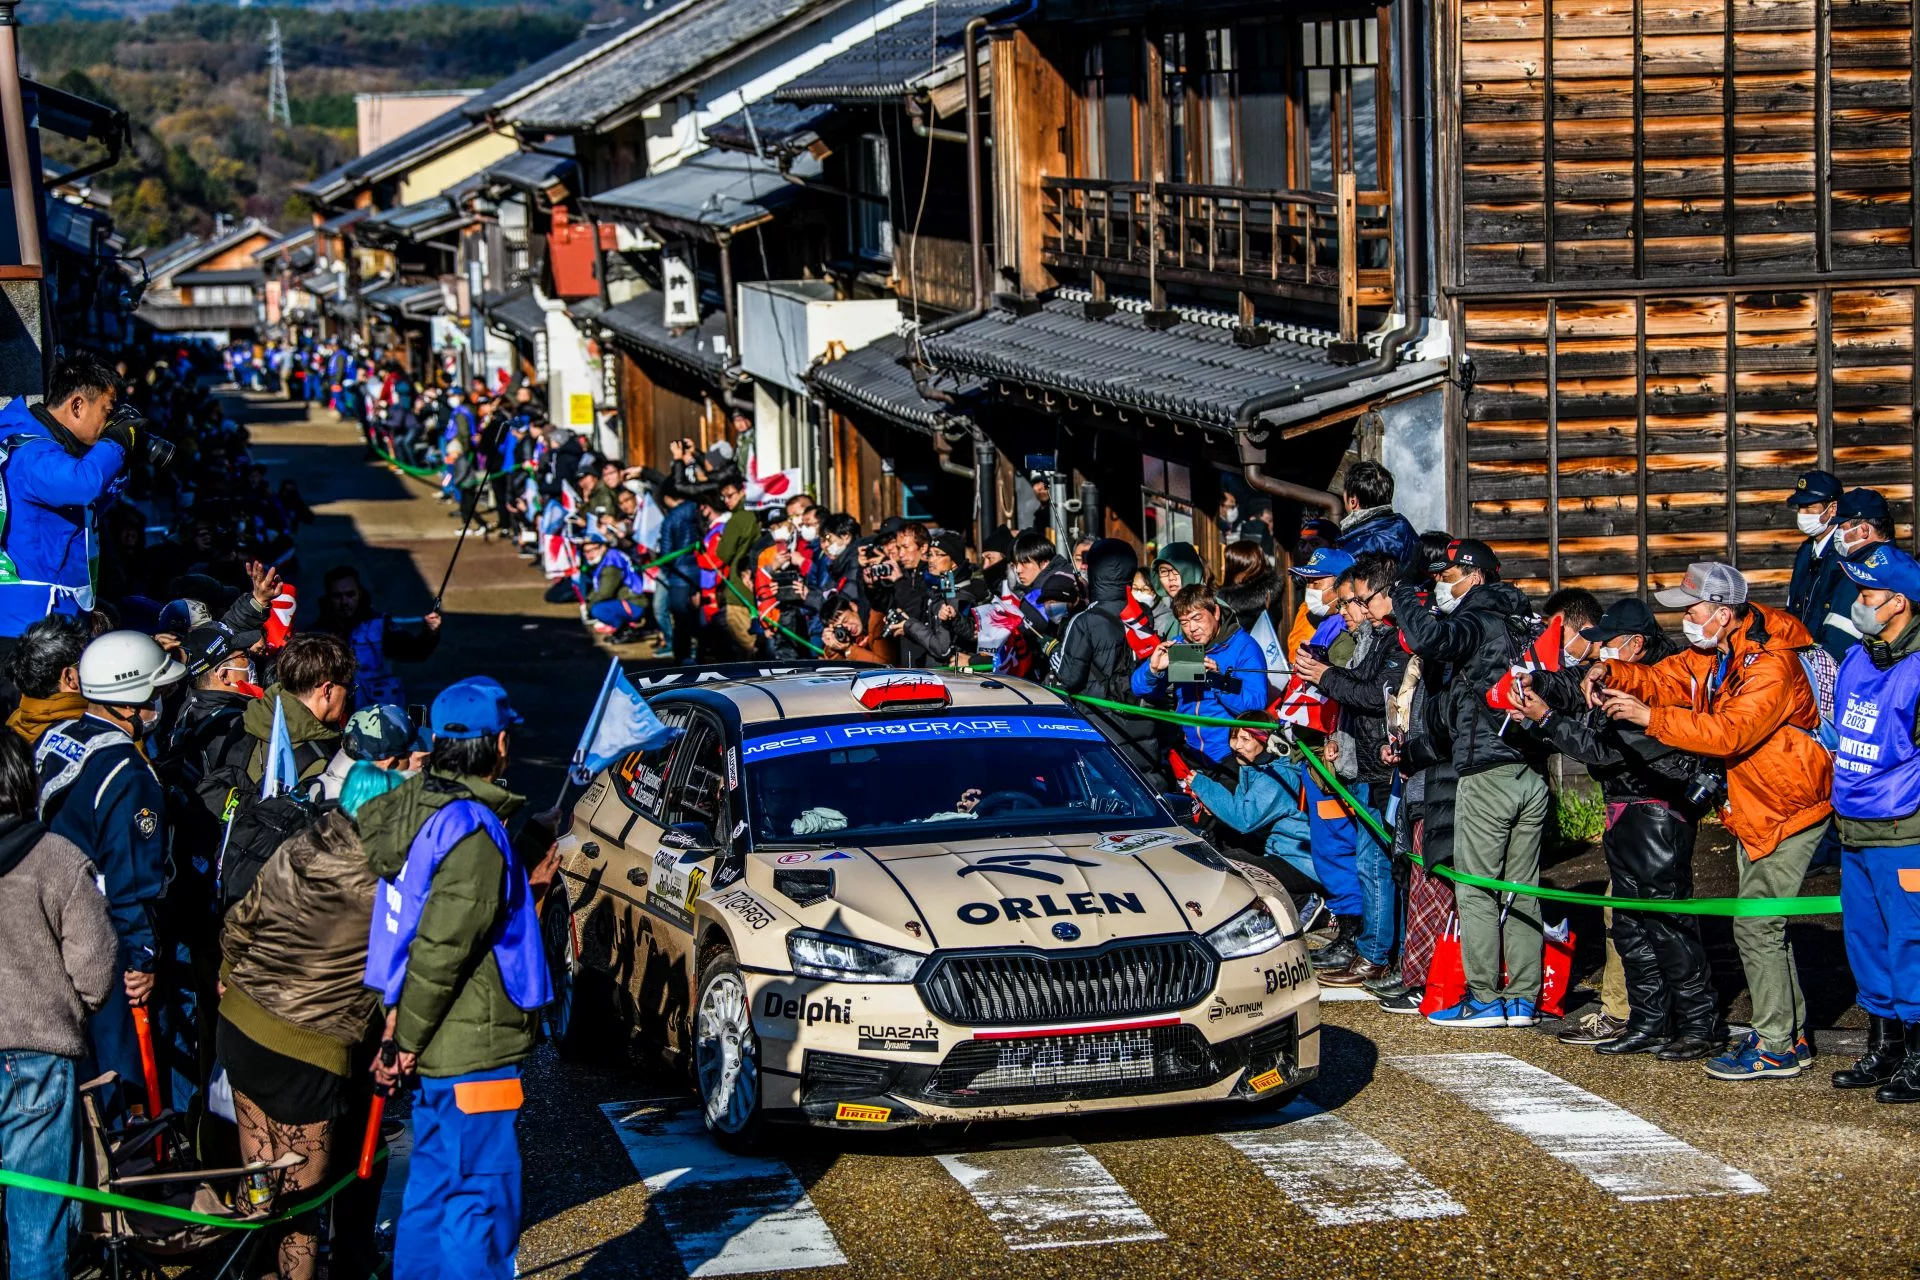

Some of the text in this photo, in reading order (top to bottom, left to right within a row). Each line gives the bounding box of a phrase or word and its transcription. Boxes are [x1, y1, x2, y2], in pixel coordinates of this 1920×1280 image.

[1846, 713, 1867, 730] 2023
[45, 734, 86, 763] POLICE
[743, 735, 817, 755] WRC2
[1850, 760, 1873, 774] STAFF
[957, 891, 1146, 925] ORLEN
[1264, 958, 1311, 995] Delphi
[764, 991, 852, 1028] Delphi
[1225, 1001, 1263, 1017] PLATINUM
[858, 1025, 938, 1039] QUAZAR
[884, 1039, 911, 1050] Dynamic
[1252, 1072, 1281, 1090] PIRELLI
[840, 1106, 888, 1120] PIRELLI
